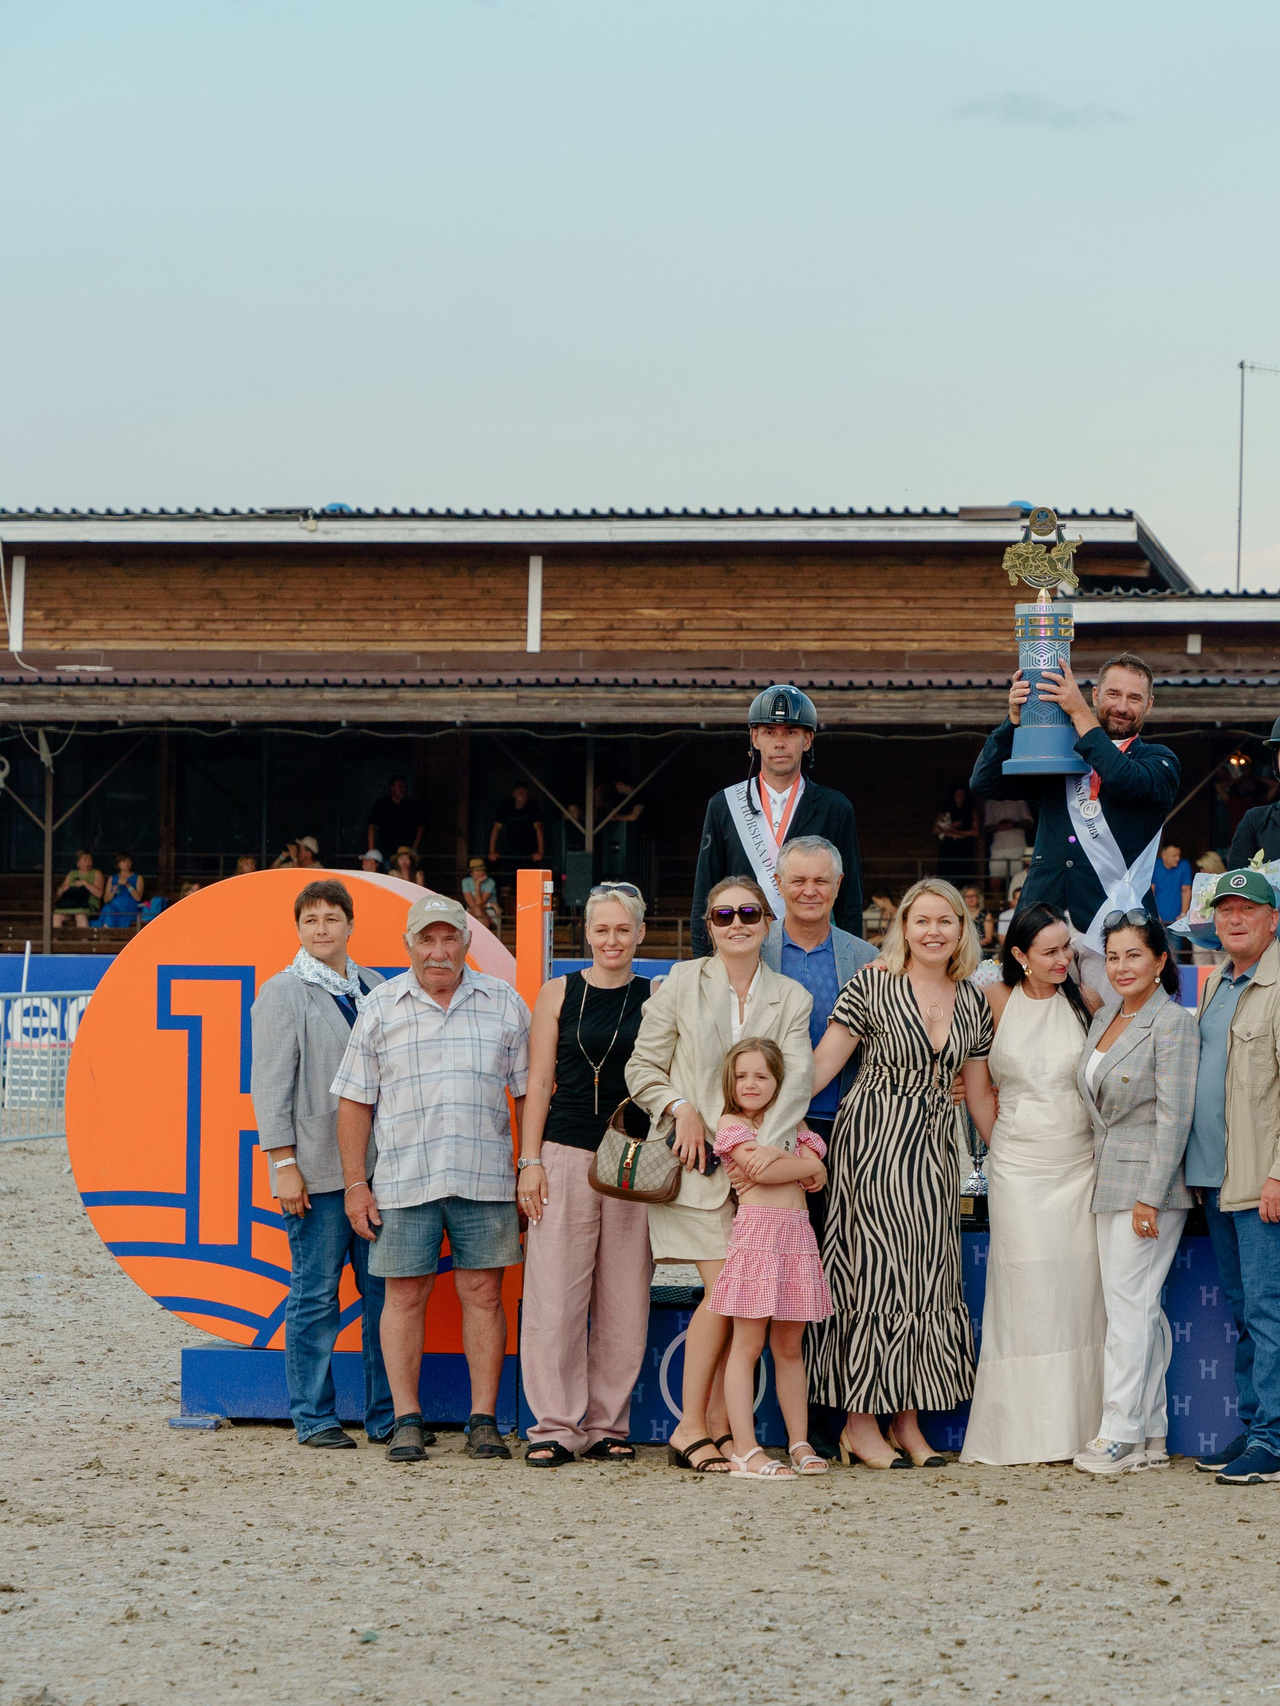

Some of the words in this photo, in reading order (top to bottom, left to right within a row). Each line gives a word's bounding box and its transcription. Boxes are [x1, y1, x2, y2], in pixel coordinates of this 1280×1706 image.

[1027, 604, 1056, 613] DERBY
[740, 803, 767, 858] HORSEKA
[1073, 776, 1087, 806] RSEK
[1085, 818, 1102, 840] ERBY
